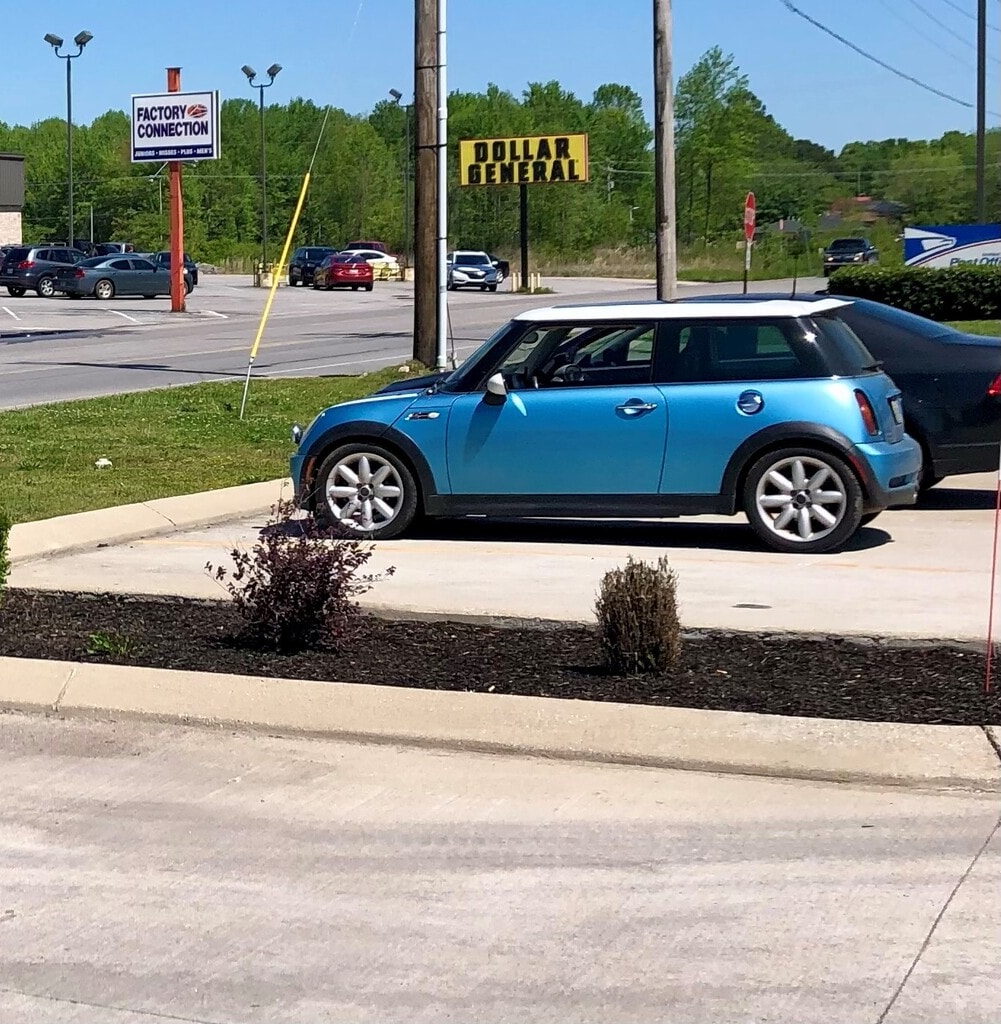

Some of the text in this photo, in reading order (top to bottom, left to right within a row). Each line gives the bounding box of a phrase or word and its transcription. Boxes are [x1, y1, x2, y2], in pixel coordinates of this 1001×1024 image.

[137, 105, 187, 121] FACTORY
[137, 121, 208, 138] CONNECTION
[474, 137, 571, 163] DOLLAR
[467, 158, 580, 184] GENERAL
